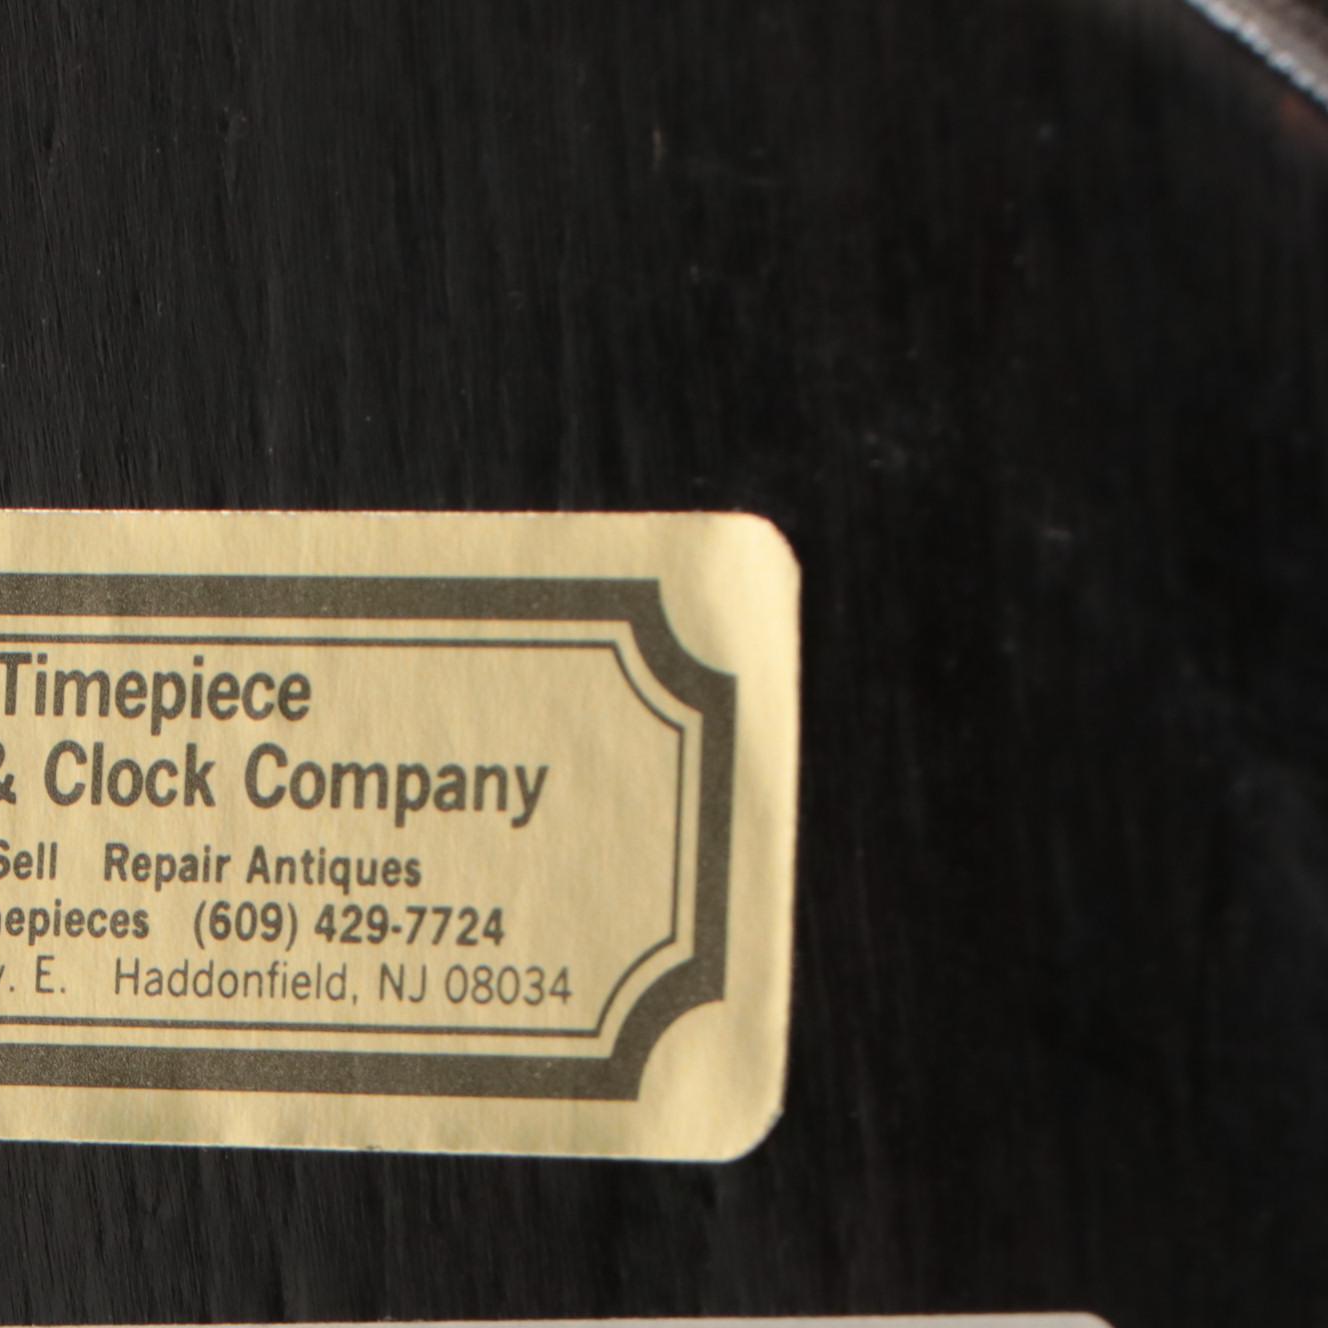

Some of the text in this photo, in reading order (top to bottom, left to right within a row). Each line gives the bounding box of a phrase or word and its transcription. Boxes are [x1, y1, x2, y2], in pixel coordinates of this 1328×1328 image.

[44, 739, 216, 808] Clock
[244, 743, 550, 830] Company
[103, 842, 232, 892] Repair
[245, 845, 422, 896] Antiques
[193, 900, 298, 952] (609)
[314, 903, 505, 947] 429-7724
[35, 954, 65, 994] E.
[114, 957, 357, 1006] Haddonfield,
[379, 963, 427, 1004] NJ
[444, 964, 572, 1006] 08034
